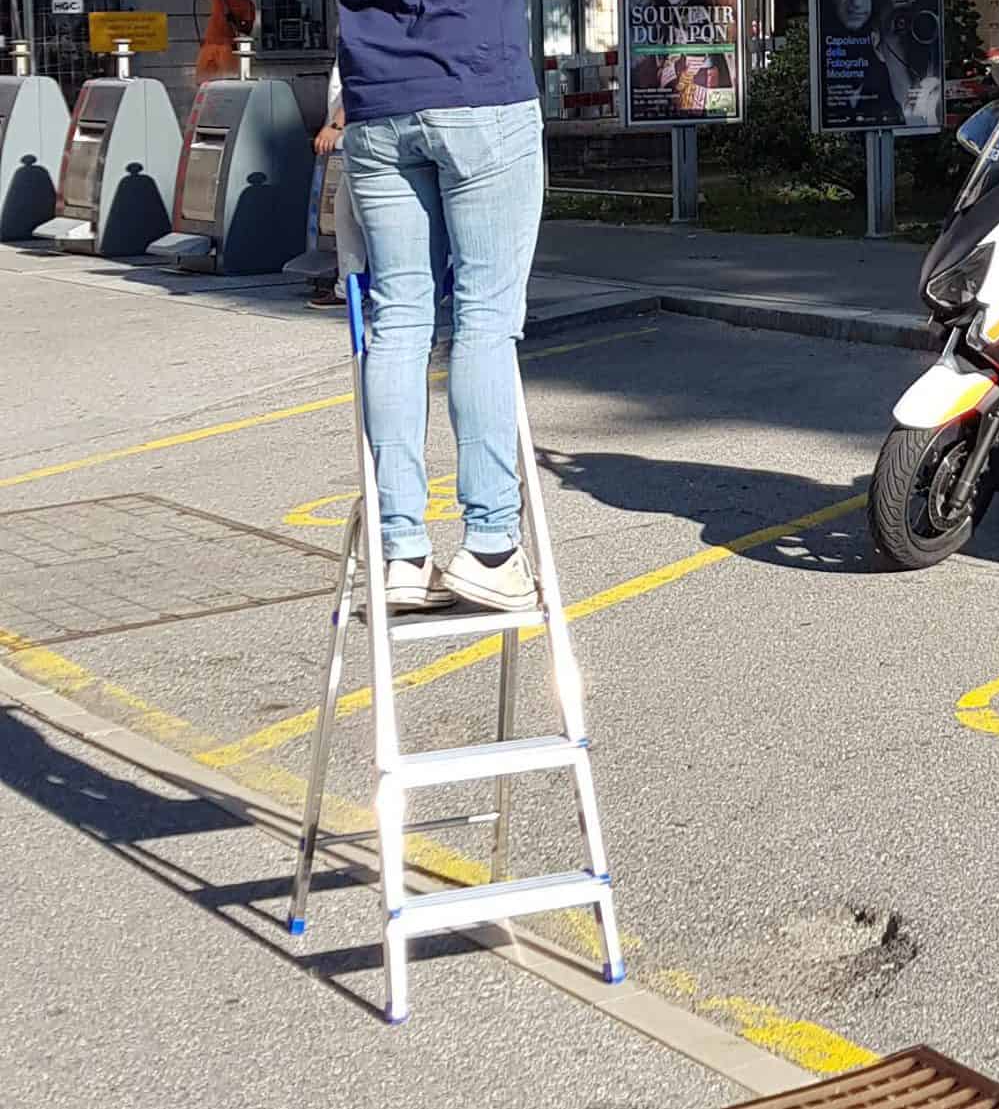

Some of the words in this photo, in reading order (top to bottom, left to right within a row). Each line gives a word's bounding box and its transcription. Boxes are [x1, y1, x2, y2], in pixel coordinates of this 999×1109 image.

[631, 5, 735, 25] SOUVENIR
[633, 25, 661, 44] DU
[666, 24, 729, 44] JAPON
